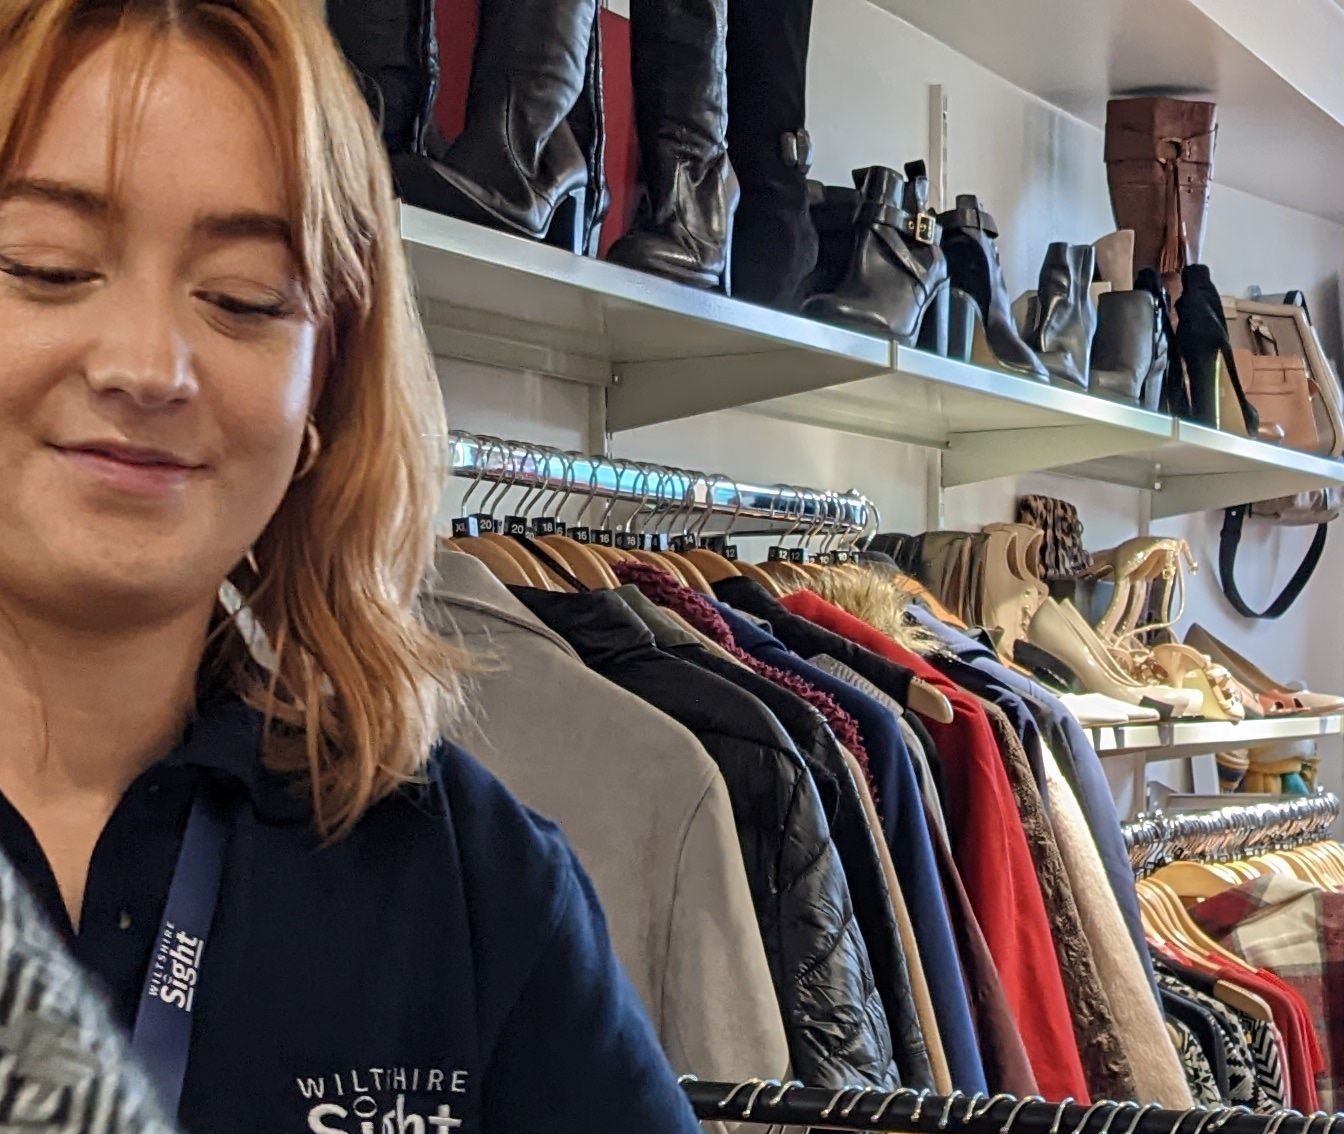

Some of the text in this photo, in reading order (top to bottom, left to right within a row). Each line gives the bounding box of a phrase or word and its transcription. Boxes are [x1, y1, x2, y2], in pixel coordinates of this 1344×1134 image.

[479, 519, 492, 530] 20
[511, 524, 524, 534] 20
[779, 550, 788, 560] 12
[148, 921, 175, 997] WILTSHIRE
[160, 930, 203, 1011] Sight
